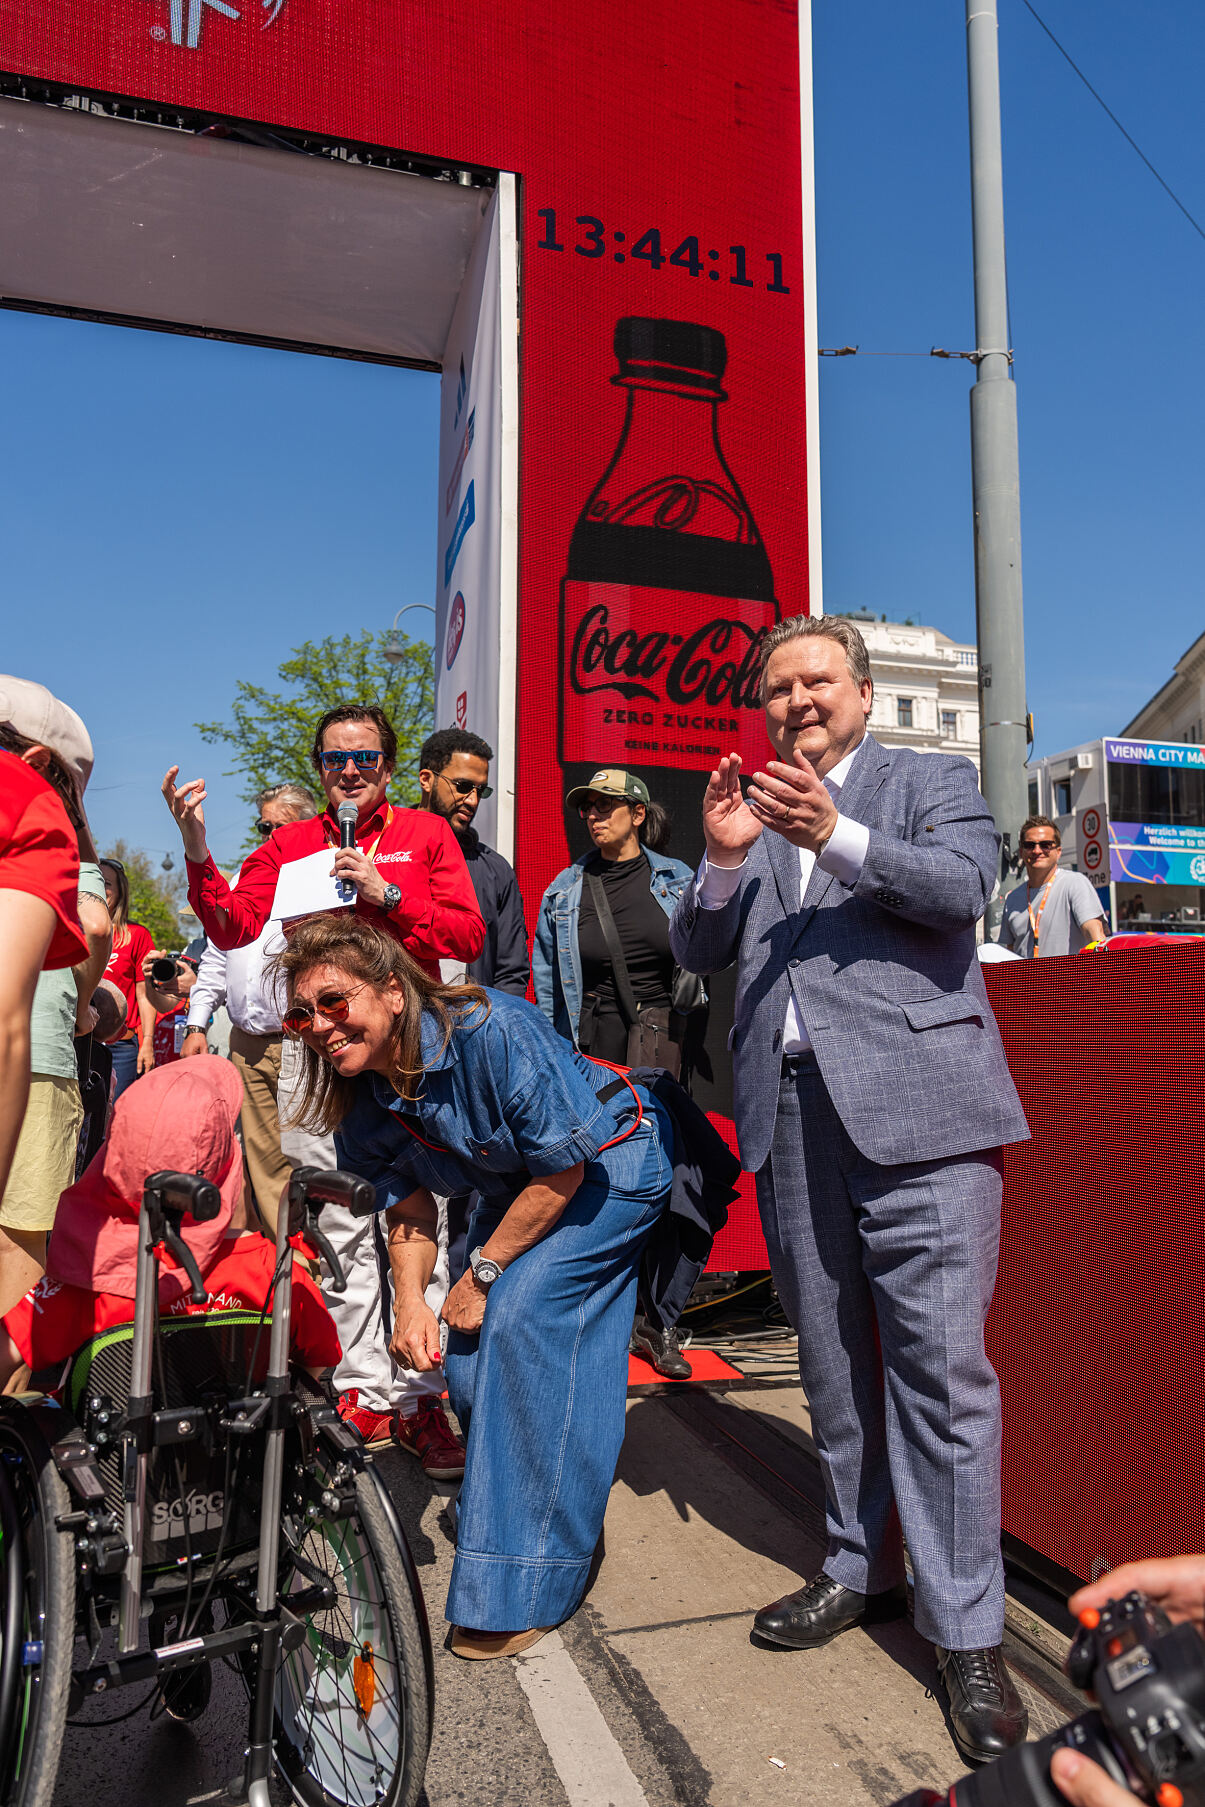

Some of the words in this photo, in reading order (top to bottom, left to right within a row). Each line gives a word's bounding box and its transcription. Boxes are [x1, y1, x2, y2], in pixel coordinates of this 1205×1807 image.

[537, 208, 790, 294] 13:44:11
[603, 709, 654, 725] ZERO
[662, 713, 739, 731] ZUCKER
[624, 740, 658, 751] KEINE
[662, 743, 720, 755] KALORIEN
[1110, 745, 1156, 761] VIENNA
[1158, 749, 1184, 762] CITY
[1087, 816, 1096, 831] 30
[1144, 826, 1177, 836] Herzlich
[1149, 836, 1184, 847] Welcome
[1187, 839, 1196, 847] to
[373, 851, 412, 864] Coca-Cola
[152, 1490, 224, 1525] SORG
